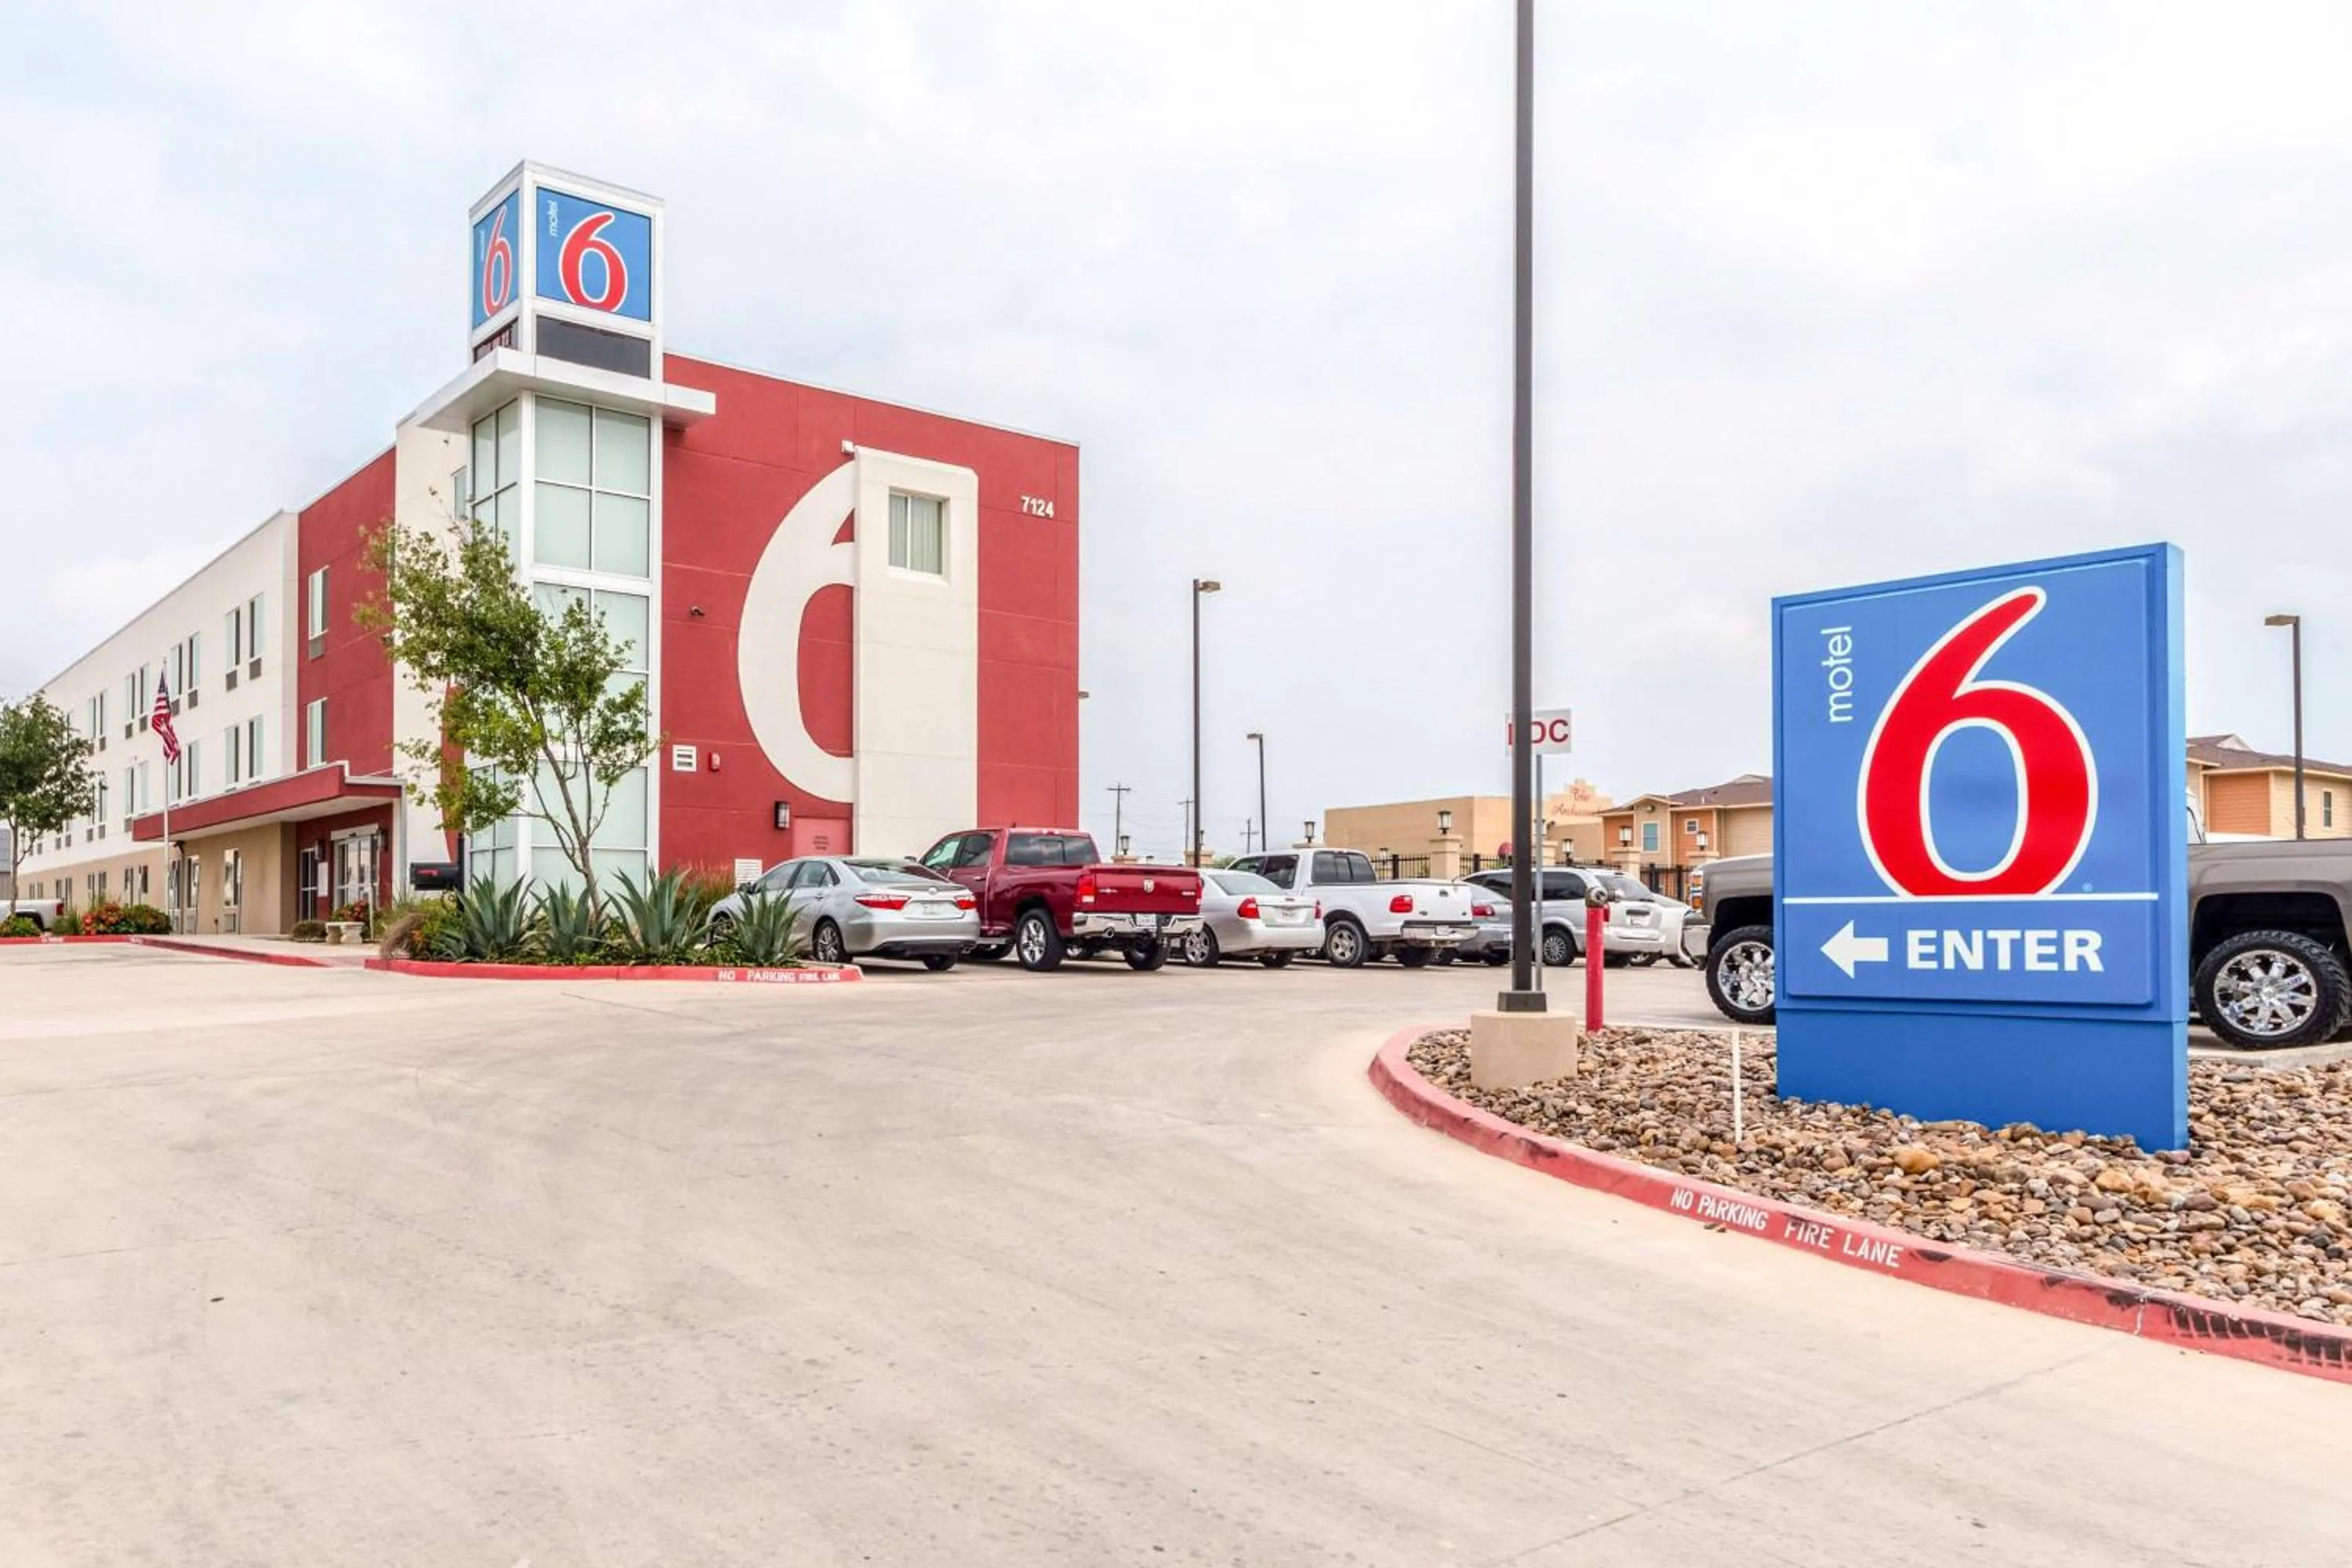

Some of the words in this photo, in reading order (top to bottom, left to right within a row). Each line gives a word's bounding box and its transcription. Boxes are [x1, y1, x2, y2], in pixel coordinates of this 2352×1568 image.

[482, 204, 512, 318] 6
[547, 200, 558, 237] motel
[558, 211, 628, 313] 6
[1021, 495, 1054, 518] 7124
[1508, 719, 1569, 745] DC
[1820, 626, 1853, 723] motel
[1857, 586, 2098, 898] 6
[718, 970, 735, 981] NO
[746, 970, 795, 982] PARKING
[1906, 929, 2104, 972] ENTER
[1670, 1188, 1692, 1210] NO
[1697, 1194, 1769, 1230] PARKING
[1784, 1220, 1835, 1249] FIRE
[1843, 1233, 1904, 1268] LANE
